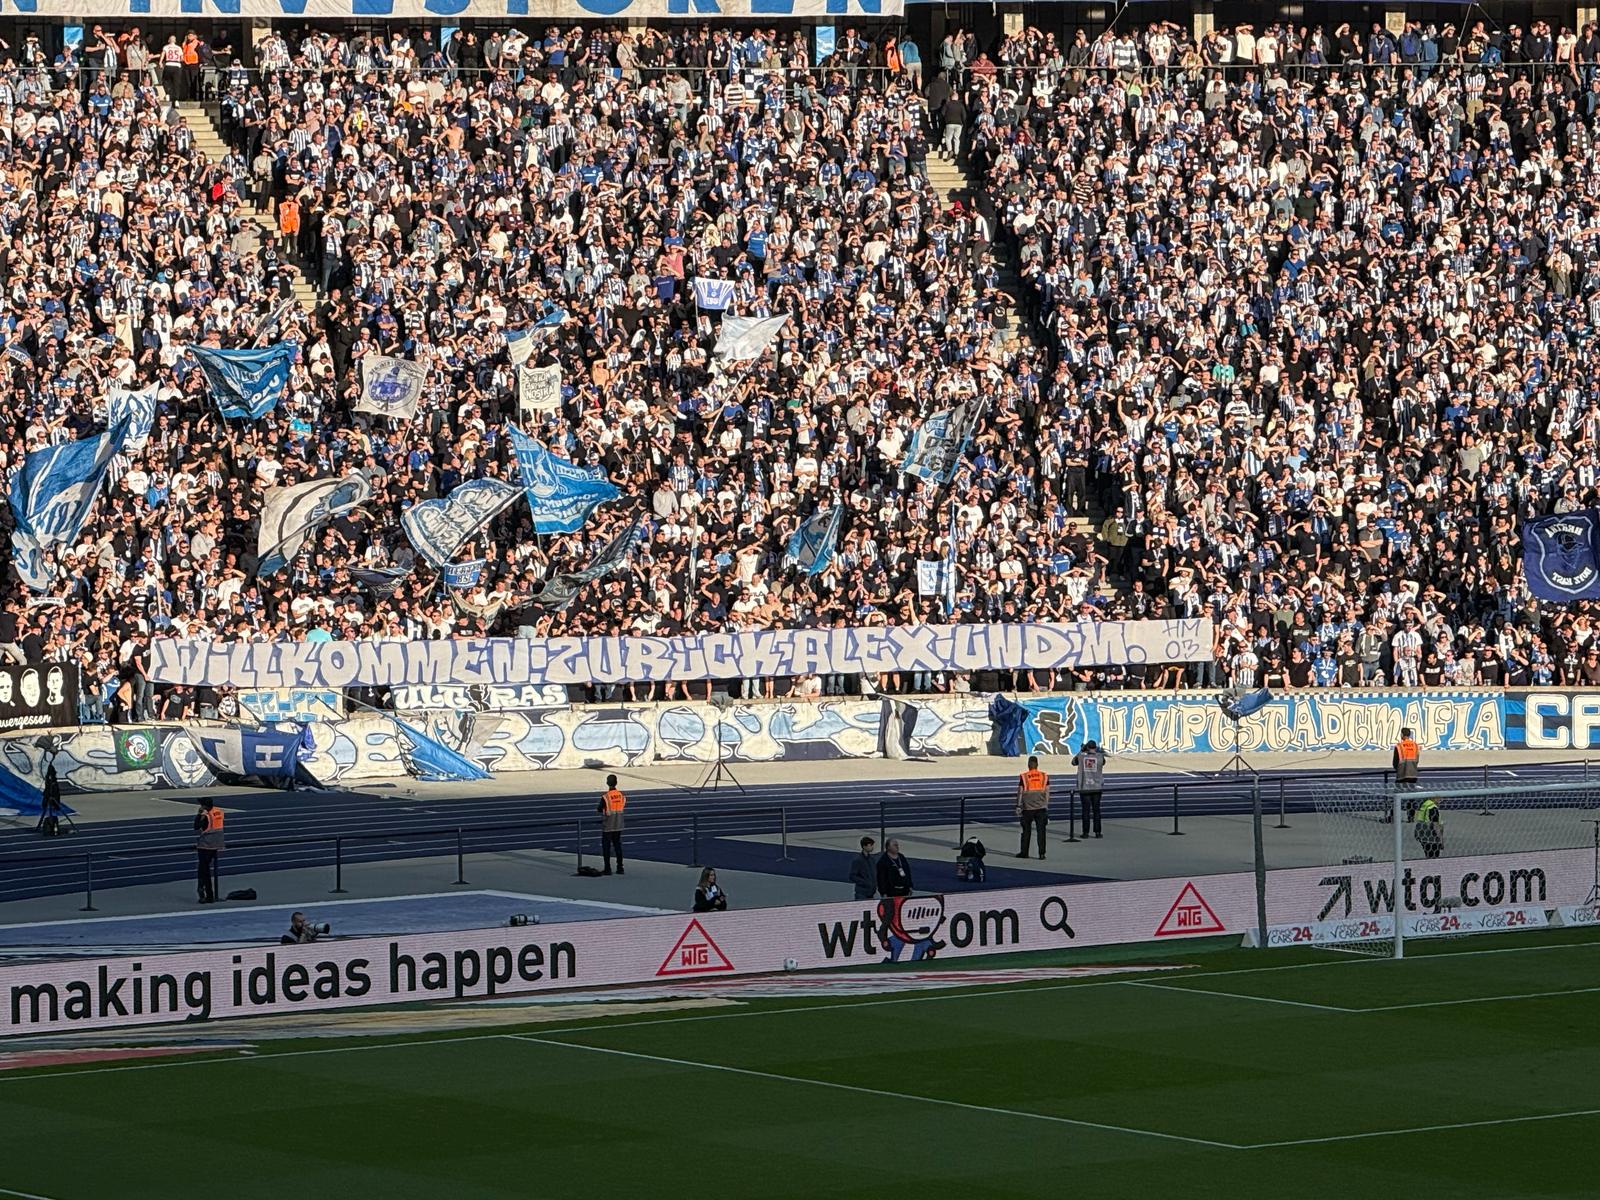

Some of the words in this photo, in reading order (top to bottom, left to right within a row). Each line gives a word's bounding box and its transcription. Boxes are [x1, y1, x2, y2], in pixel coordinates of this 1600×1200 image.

[954, 623, 1073, 669] UND
[1097, 699, 1504, 752] HAUPTSTADTMAFIA
[1177, 905, 1202, 927] WTG
[680, 944, 709, 966] WTG
[11, 962, 212, 1024] making
[232, 953, 371, 1007] ideas
[389, 941, 576, 997] happen
